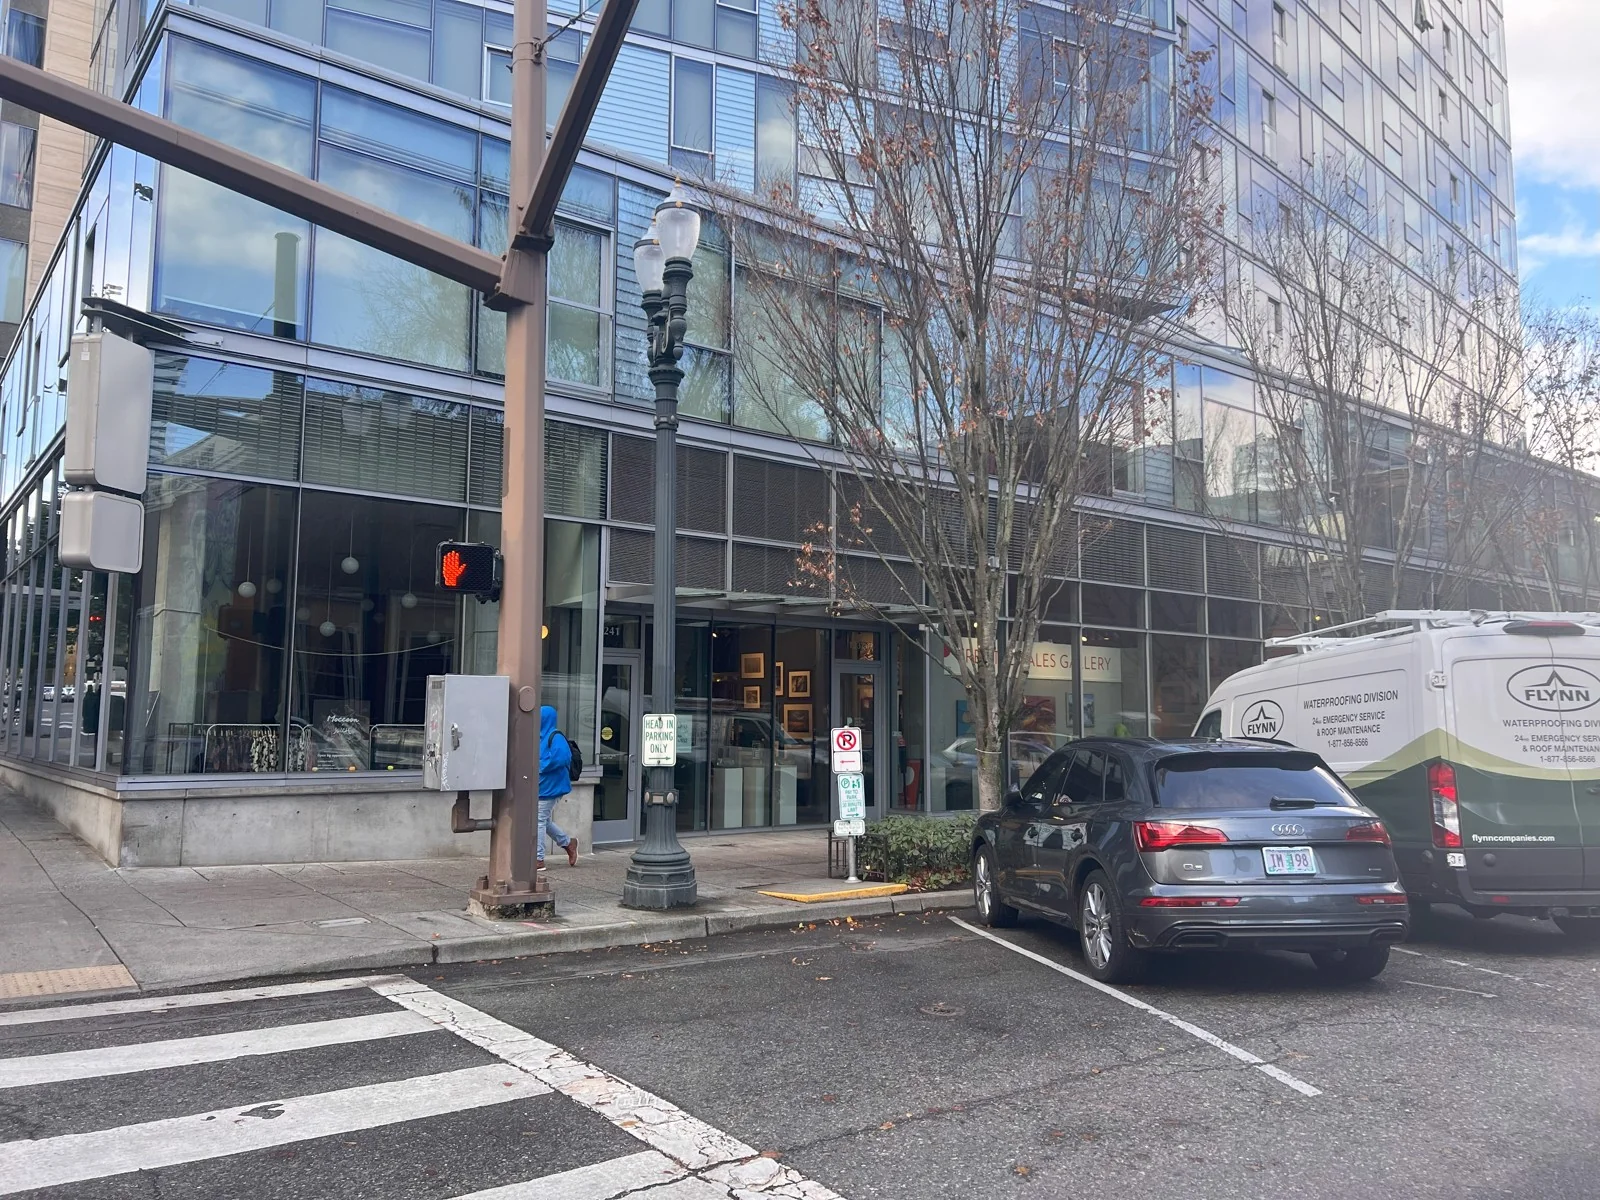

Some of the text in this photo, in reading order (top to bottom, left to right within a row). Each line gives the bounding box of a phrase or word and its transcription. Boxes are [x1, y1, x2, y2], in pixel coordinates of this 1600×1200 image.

[1029, 653, 1056, 667] ALES
[1060, 655, 1111, 670] GLERY
[1303, 690, 1398, 709] WATERPROOFING DIVISION
[1524, 689, 1590, 701] FLYNN
[1323, 713, 1358, 724] EMERGENCY
[1359, 711, 1385, 721] SERVICE
[645, 720, 674, 729] HEAD IN
[1247, 721, 1276, 735] FLYNN
[1503, 720, 1582, 728] WATERPROOFING
[1322, 728, 1336, 736] ROOF
[1338, 725, 1381, 735] MAINTENANCE
[645, 732, 674, 741] PARKING
[1328, 738, 1368, 748] 1-877-856-8566
[650, 744, 668, 753] ONLY
[1472, 834, 1555, 843] flynncompanies.com
